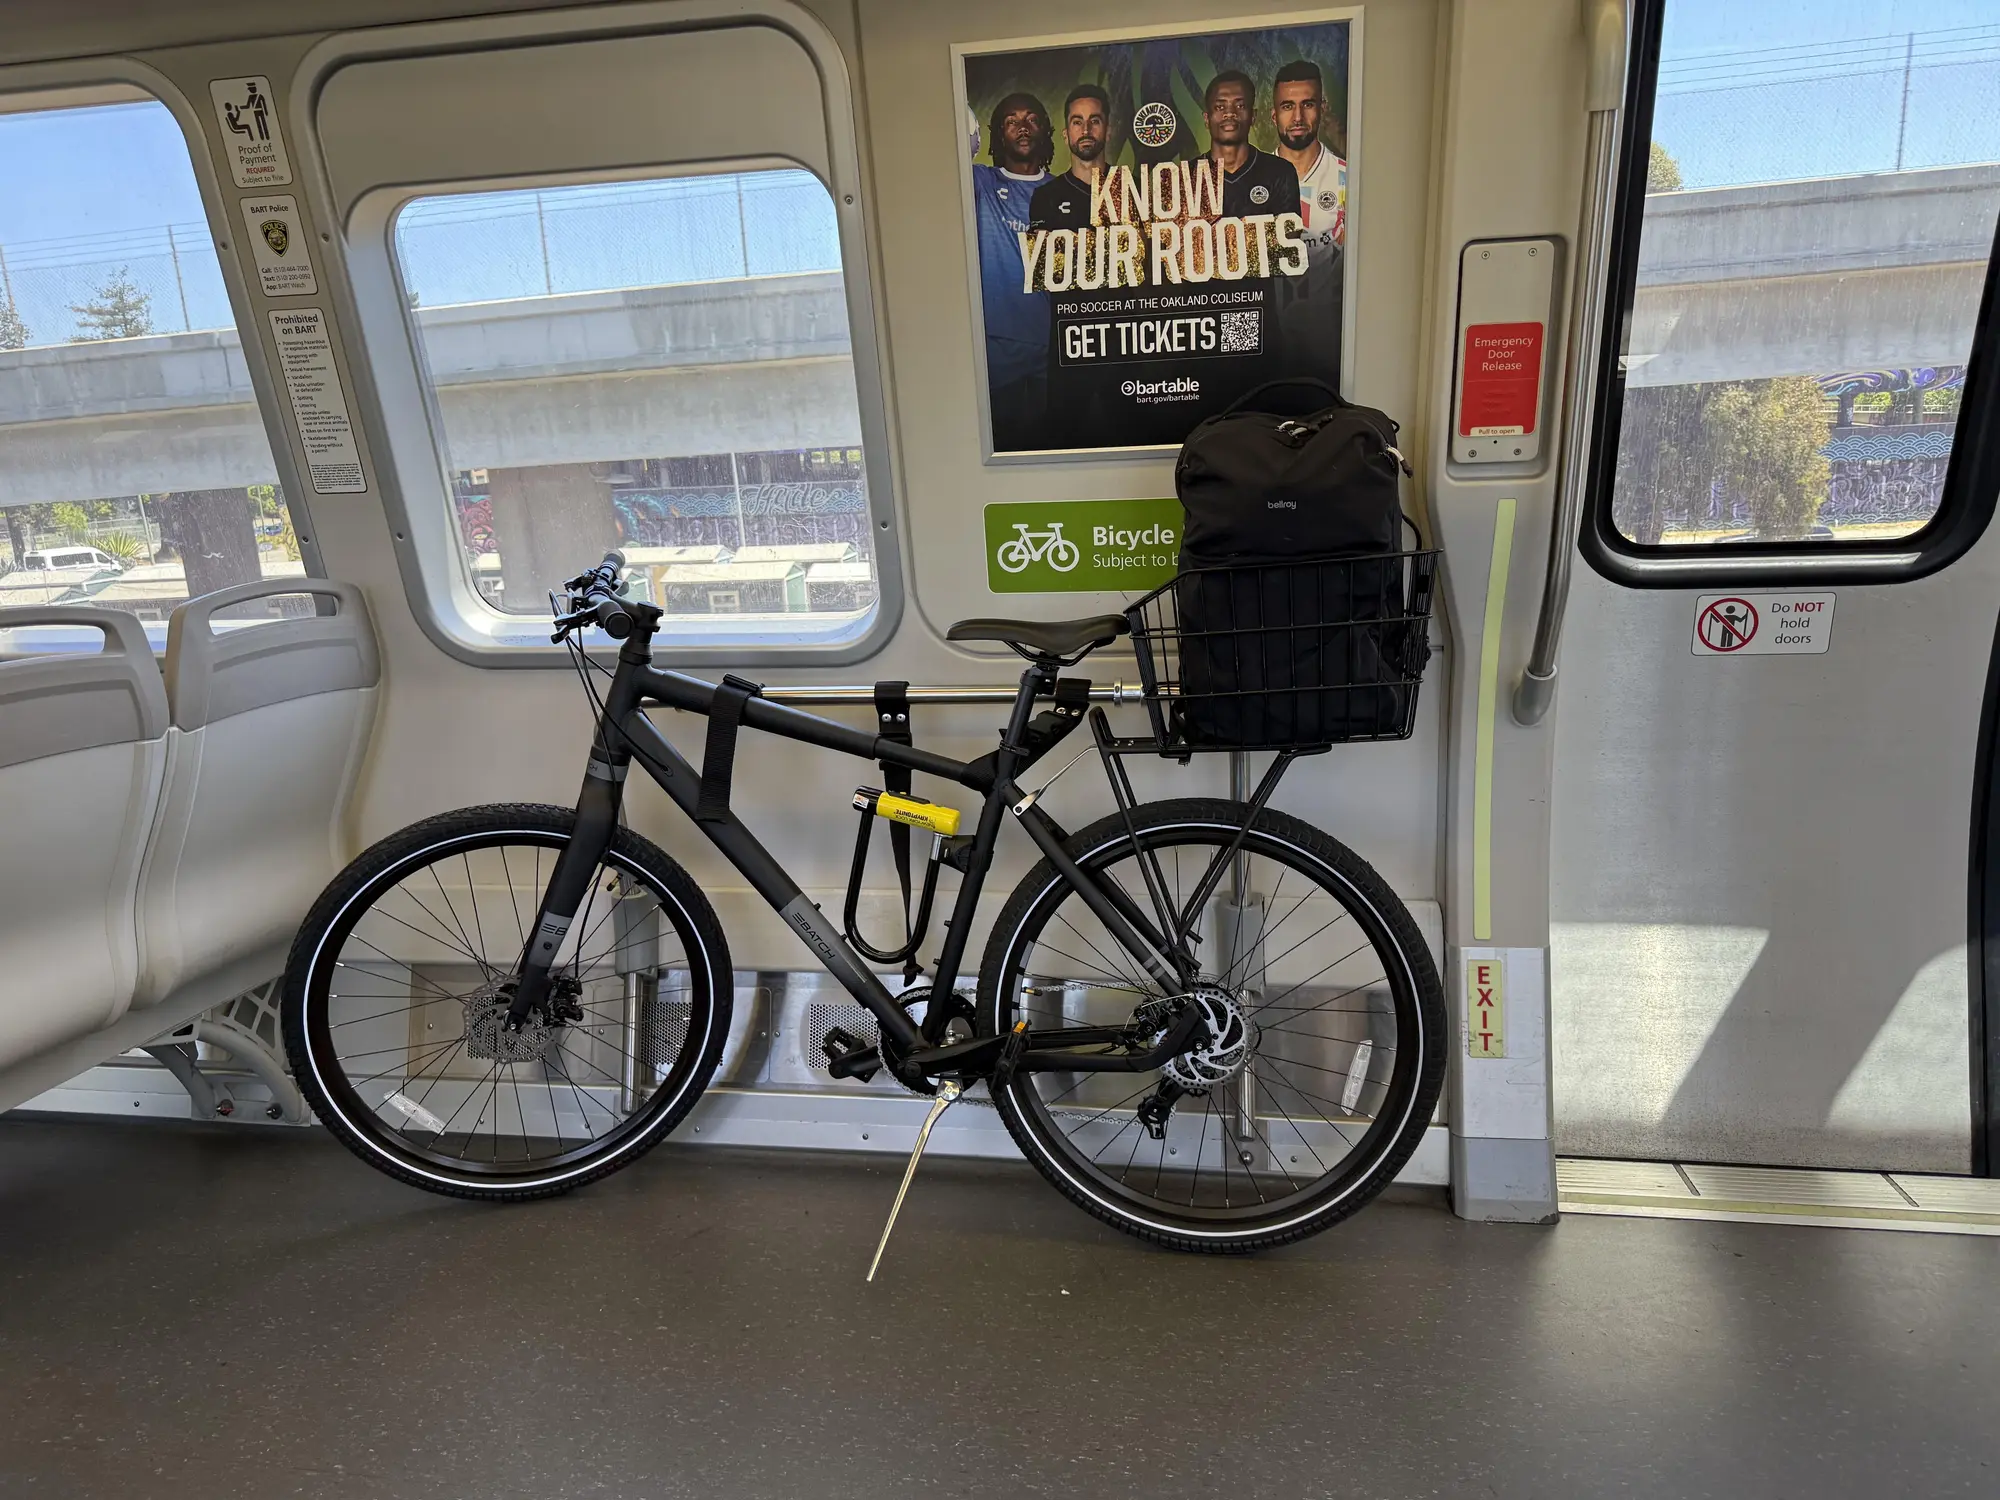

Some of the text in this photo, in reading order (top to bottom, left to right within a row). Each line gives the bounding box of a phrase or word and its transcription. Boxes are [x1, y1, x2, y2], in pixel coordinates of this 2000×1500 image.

[238, 142, 272, 155] Proof of
[240, 154, 277, 166] Payment
[246, 165, 276, 174] REQUIRED
[242, 176, 263, 184] Subject
[1090, 157, 1225, 226] KNOW
[250, 204, 289, 214] BART Police
[263, 222, 287, 232] POLICE
[1017, 212, 1311, 294] YOUR ROOTS
[1057, 290, 1264, 314] PRO SOCCER AT THE OAKLAND COLISEUM
[275, 314, 318, 324] Prohibited
[294, 325, 317, 334] BART
[1065, 317, 1216, 359] GET TICKETS
[1474, 336, 1534, 348] Emergency
[1488, 349, 1515, 359] Door
[1482, 361, 1522, 372] Release
[1136, 377, 1200, 395] bartable
[1136, 393, 1200, 404] bart.gov/bartable
[1267, 500, 1297, 510] bellroy
[1092, 523, 1175, 551] Bicycle
[1092, 553, 1147, 571] Subject
[1151, 553, 1167, 567] to
[1771, 601, 1825, 613] Do NOT
[1780, 617, 1810, 629] hold
[1774, 633, 1811, 644] doors
[895, 808, 929, 822] KRYPTONITE
[1476, 965, 1495, 1051] EXIT
